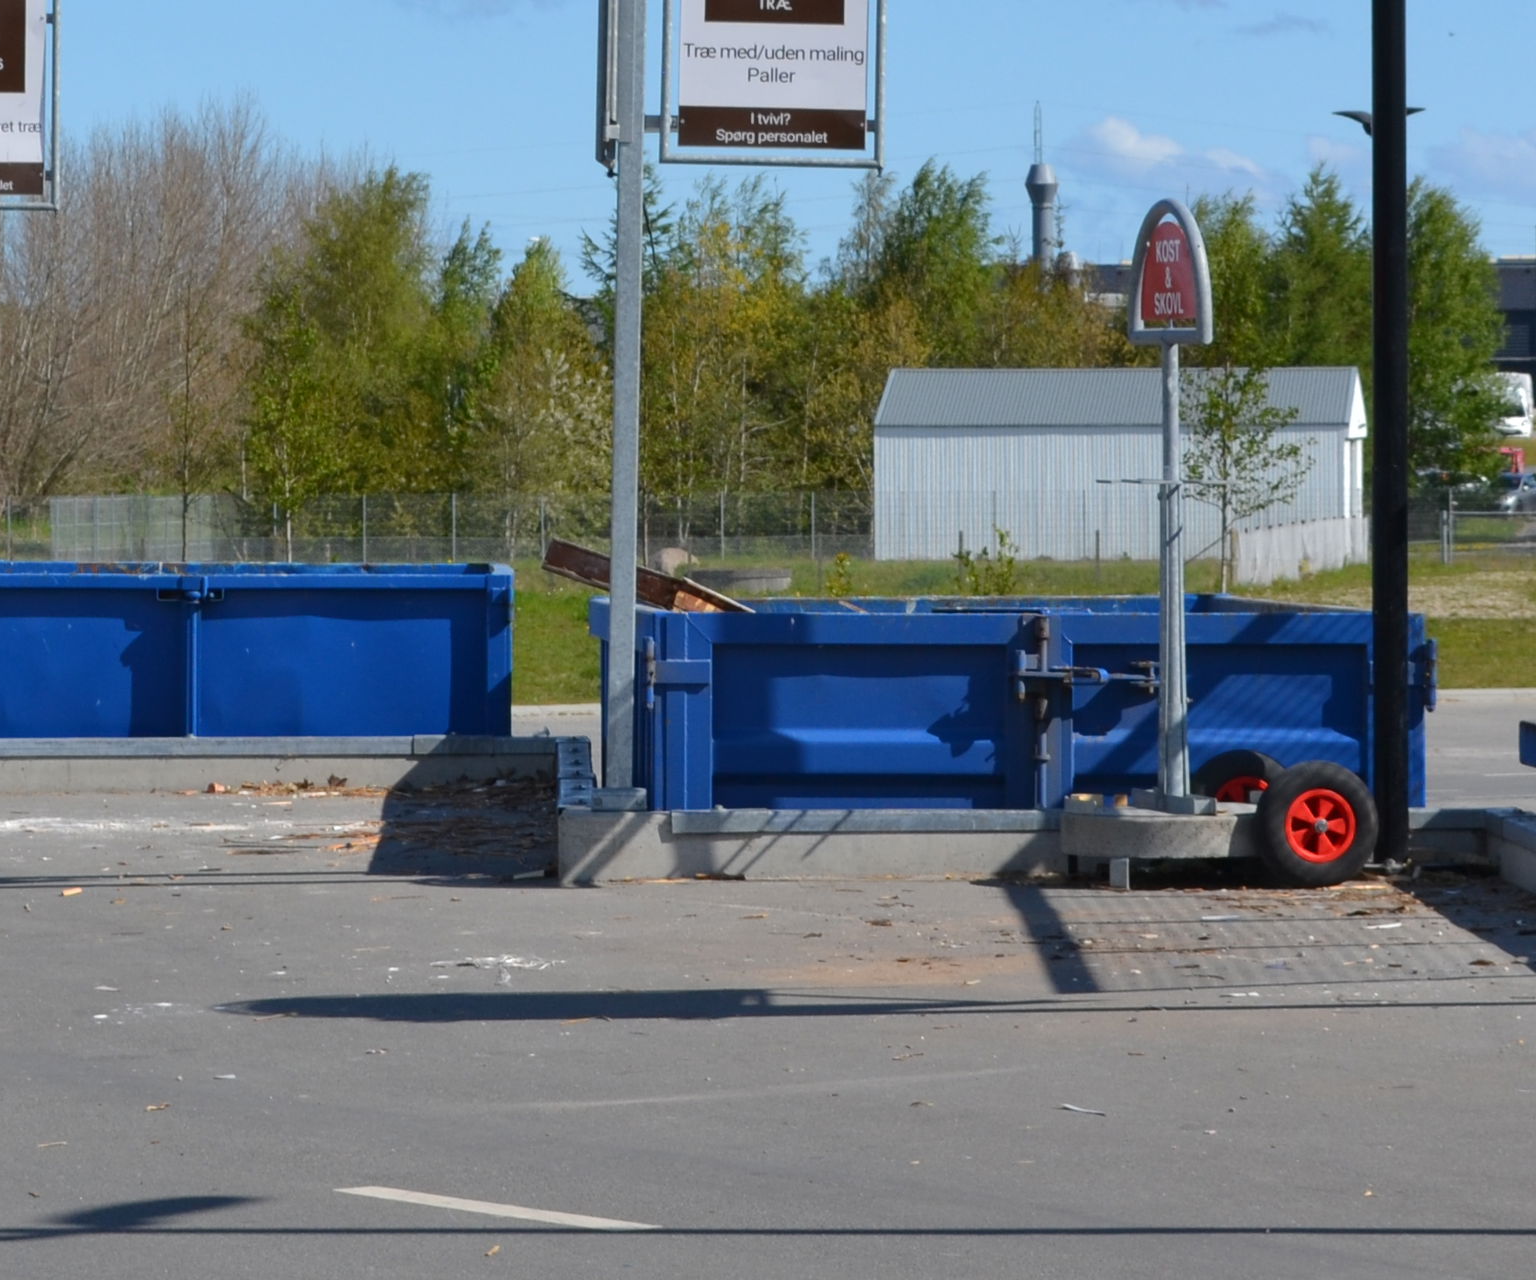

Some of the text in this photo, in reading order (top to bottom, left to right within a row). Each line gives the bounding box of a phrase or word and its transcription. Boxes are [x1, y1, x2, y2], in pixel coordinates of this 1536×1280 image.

[683, 43, 865, 65] Træ med/uden maling
[747, 67, 796, 83] Paller
[750, 112, 792, 126] I tvivl?
[715, 129, 828, 144] Spørg personalet
[1155, 239, 1181, 263] KOST
[1164, 266, 1172, 289] &
[1154, 291, 1184, 316] SKOVL
